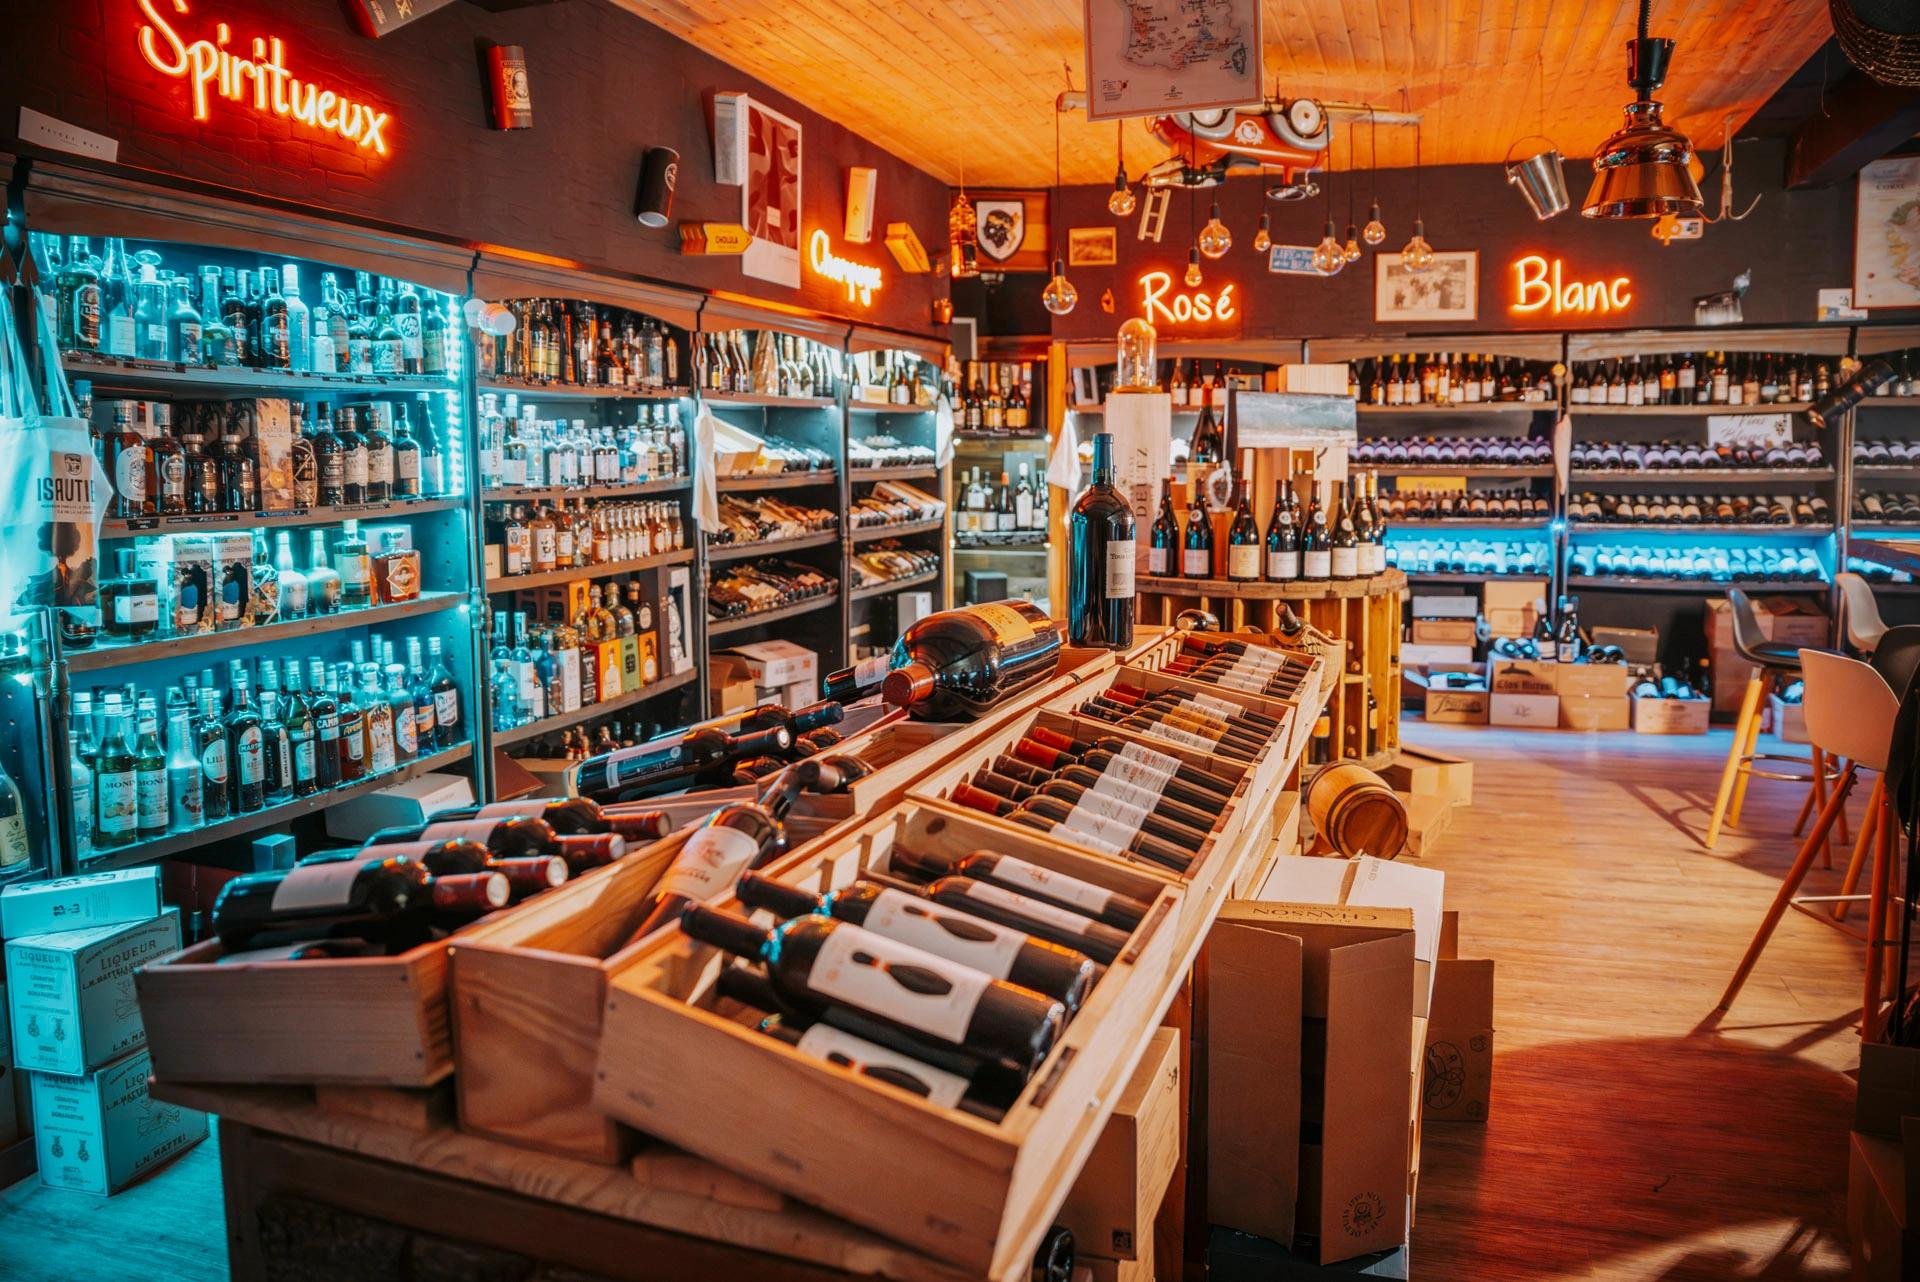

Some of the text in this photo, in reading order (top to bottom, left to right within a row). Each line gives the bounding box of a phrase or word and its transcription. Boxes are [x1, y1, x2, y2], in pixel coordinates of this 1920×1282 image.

[137, 0, 392, 155] Spiritueux
[1138, 271, 1236, 323] Rosé
[1511, 255, 1632, 314] Blanc
[1252, 907, 1378, 922] CHANSON
[19, 950, 61, 964] LIQUEUR
[101, 939, 157, 970] LIQUEUR
